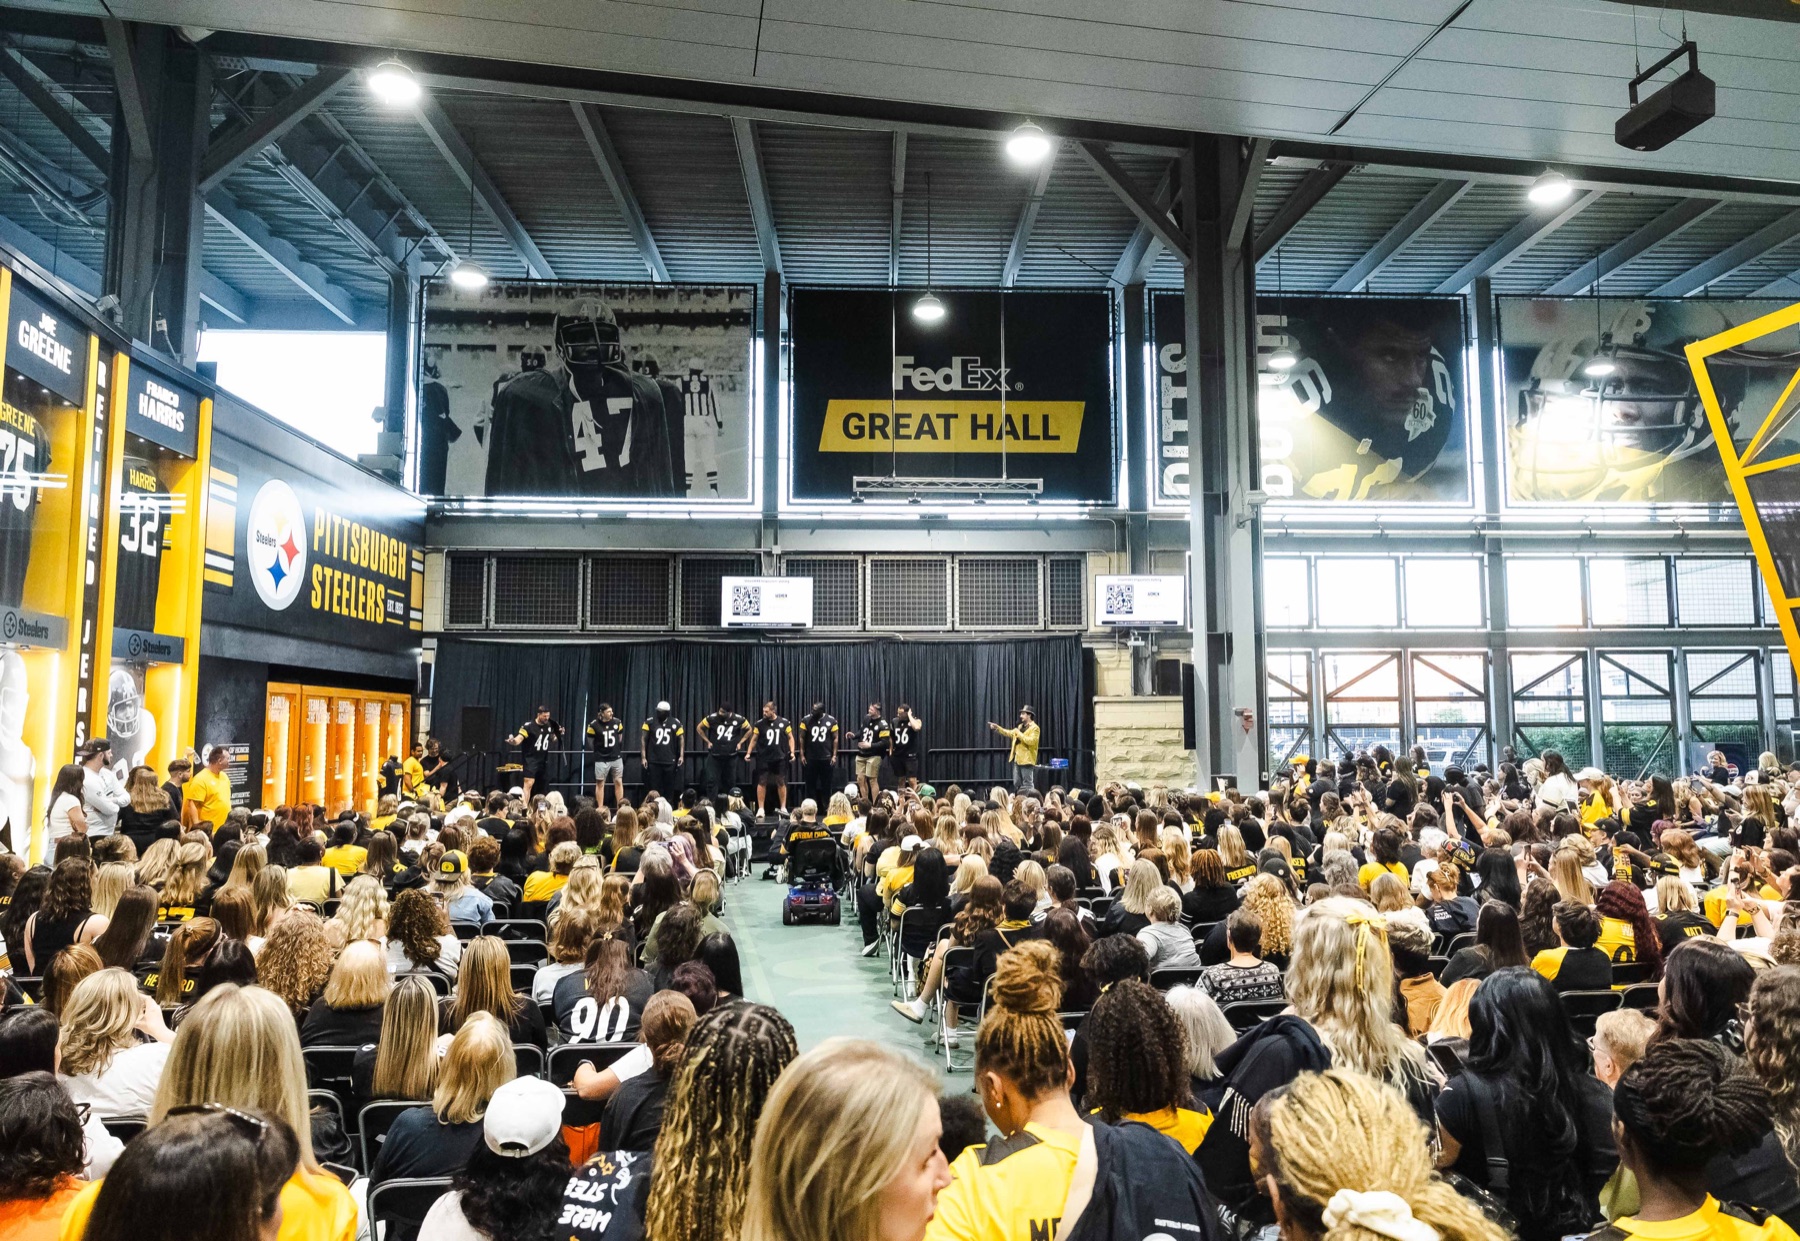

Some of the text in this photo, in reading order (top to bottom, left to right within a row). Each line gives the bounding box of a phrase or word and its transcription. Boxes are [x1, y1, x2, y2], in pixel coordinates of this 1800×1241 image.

[38, 313, 58, 337] JOE
[18, 320, 72, 375] GREENE
[146, 381, 180, 407] FRANCO
[138, 393, 185, 432] HARRIS
[1412, 402, 1426, 420] 60
[572, 397, 633, 472] 47
[842, 412, 1061, 441] GREAT HALL
[86, 361, 106, 586] RETIRED
[129, 469, 157, 493] HARRIS
[121, 491, 160, 558] 32
[256, 529, 277, 548] Steelers
[313, 506, 407, 581] PITTSBURGH
[311, 563, 385, 625] STEELERS
[18, 620, 49, 640] Steelers
[142, 640, 172, 656] Steelers
[534, 734, 549, 751] 46
[602, 729, 616, 747] 15
[655, 728, 671, 745] 95
[716, 724, 735, 741] 94
[766, 728, 780, 746] 91
[811, 725, 828, 742] 93
[894, 727, 909, 744] 56
[143, 973, 195, 992] HERD
[568, 995, 630, 1044] 90
